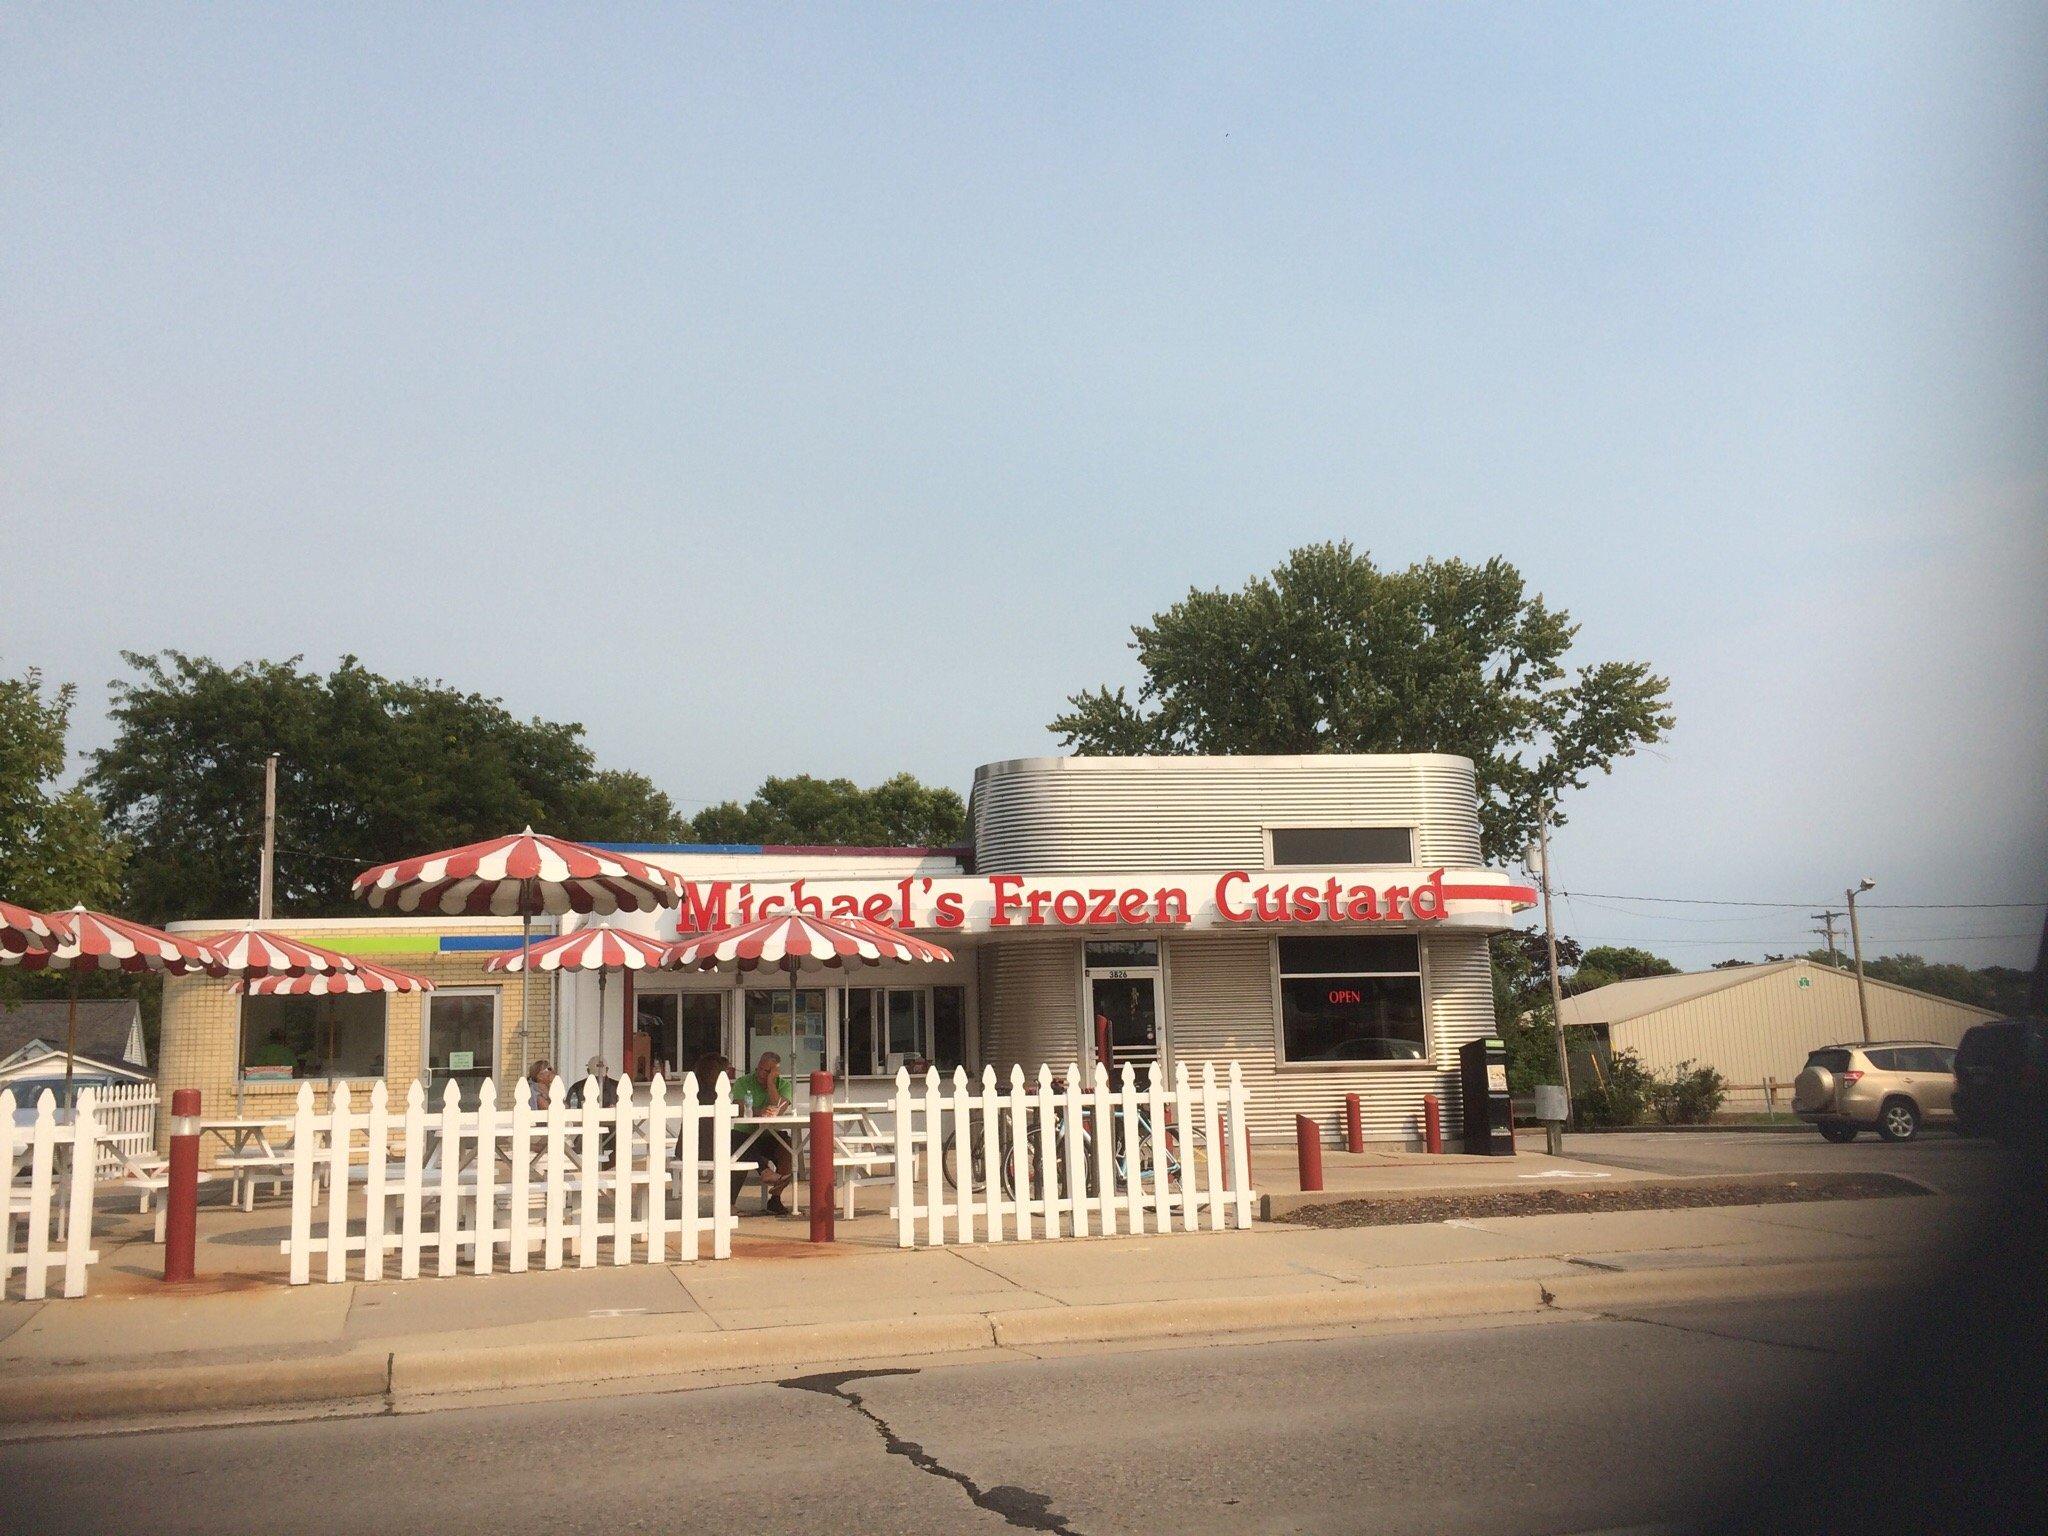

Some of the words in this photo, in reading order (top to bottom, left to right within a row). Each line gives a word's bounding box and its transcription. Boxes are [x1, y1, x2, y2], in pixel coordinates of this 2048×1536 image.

[676, 876, 965, 932] Michael's
[989, 875, 1191, 925] Frozen
[1215, 867, 1449, 922] Custard
[1329, 990, 1360, 1004] OPEN
